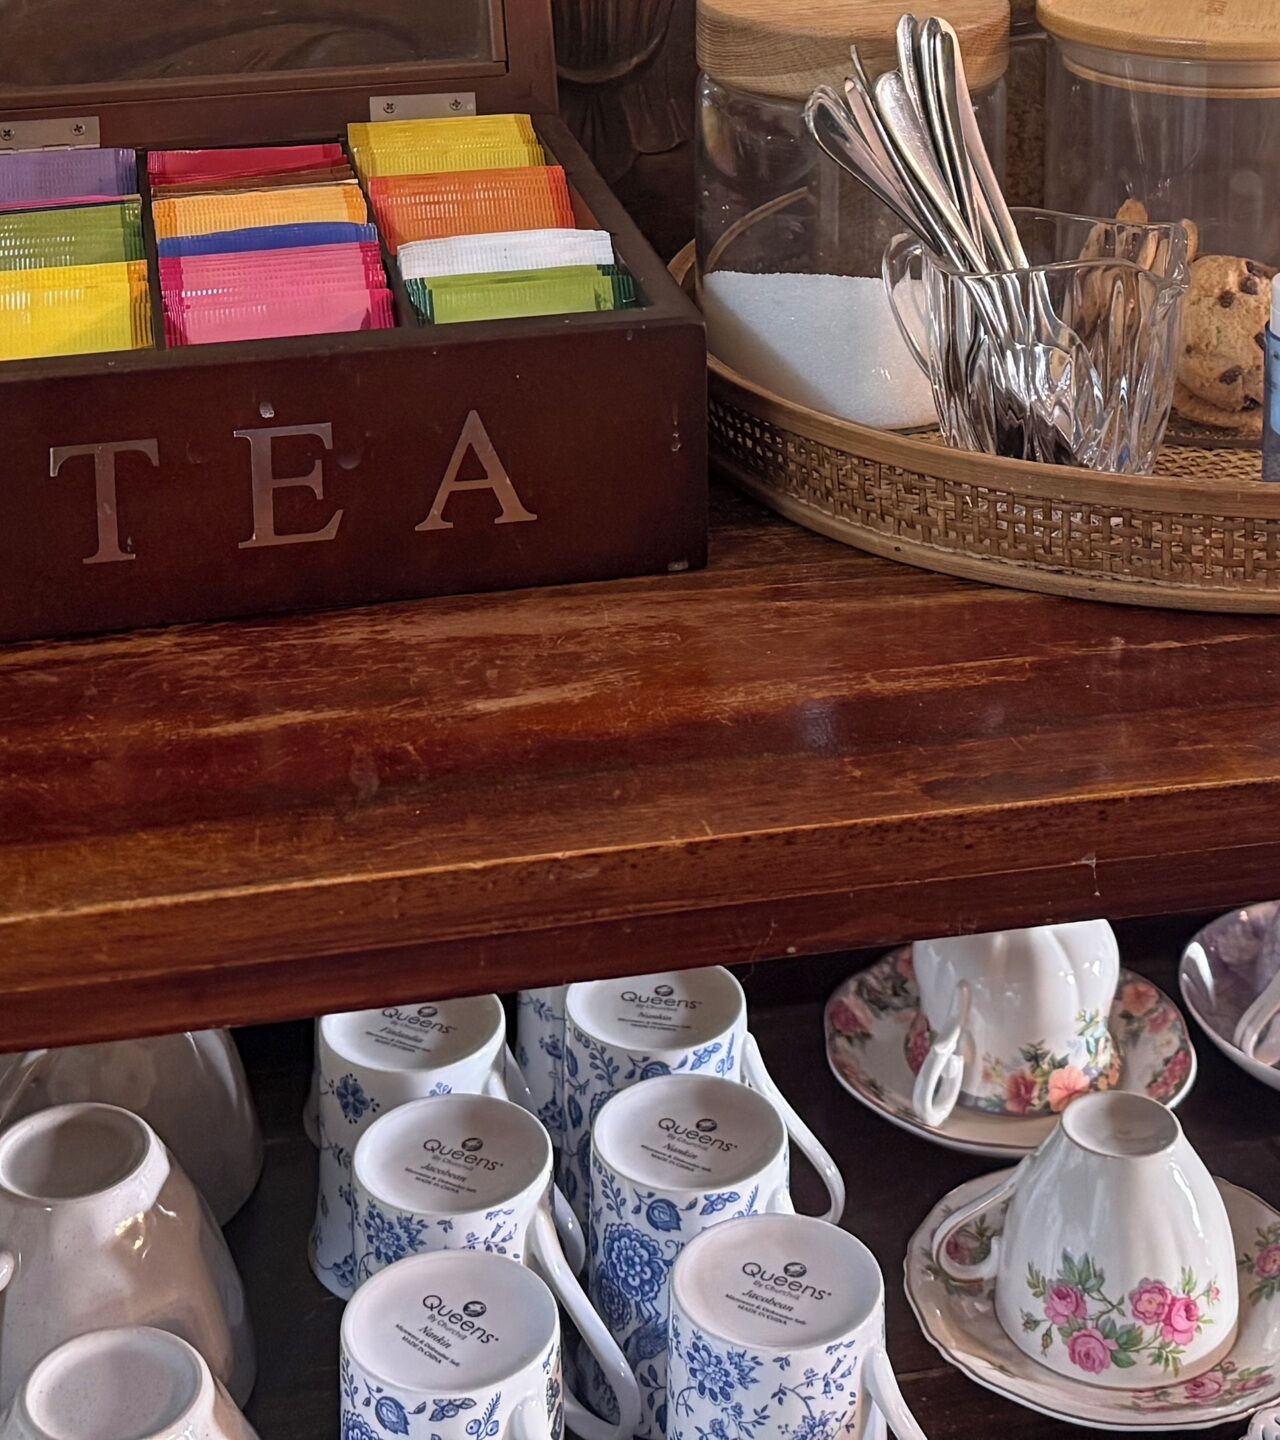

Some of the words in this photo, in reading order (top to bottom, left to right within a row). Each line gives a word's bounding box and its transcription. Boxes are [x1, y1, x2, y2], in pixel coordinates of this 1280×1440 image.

[621, 991, 697, 1009] Queens
[382, 1007, 451, 1034] Queens
[658, 1118, 733, 1152] Queens
[424, 1139, 498, 1170] Queens
[742, 1262, 826, 1300] Queens
[742, 1289, 794, 1312] Jacobean
[423, 1295, 494, 1344] Queens
[419, 1325, 452, 1349] Nankin
